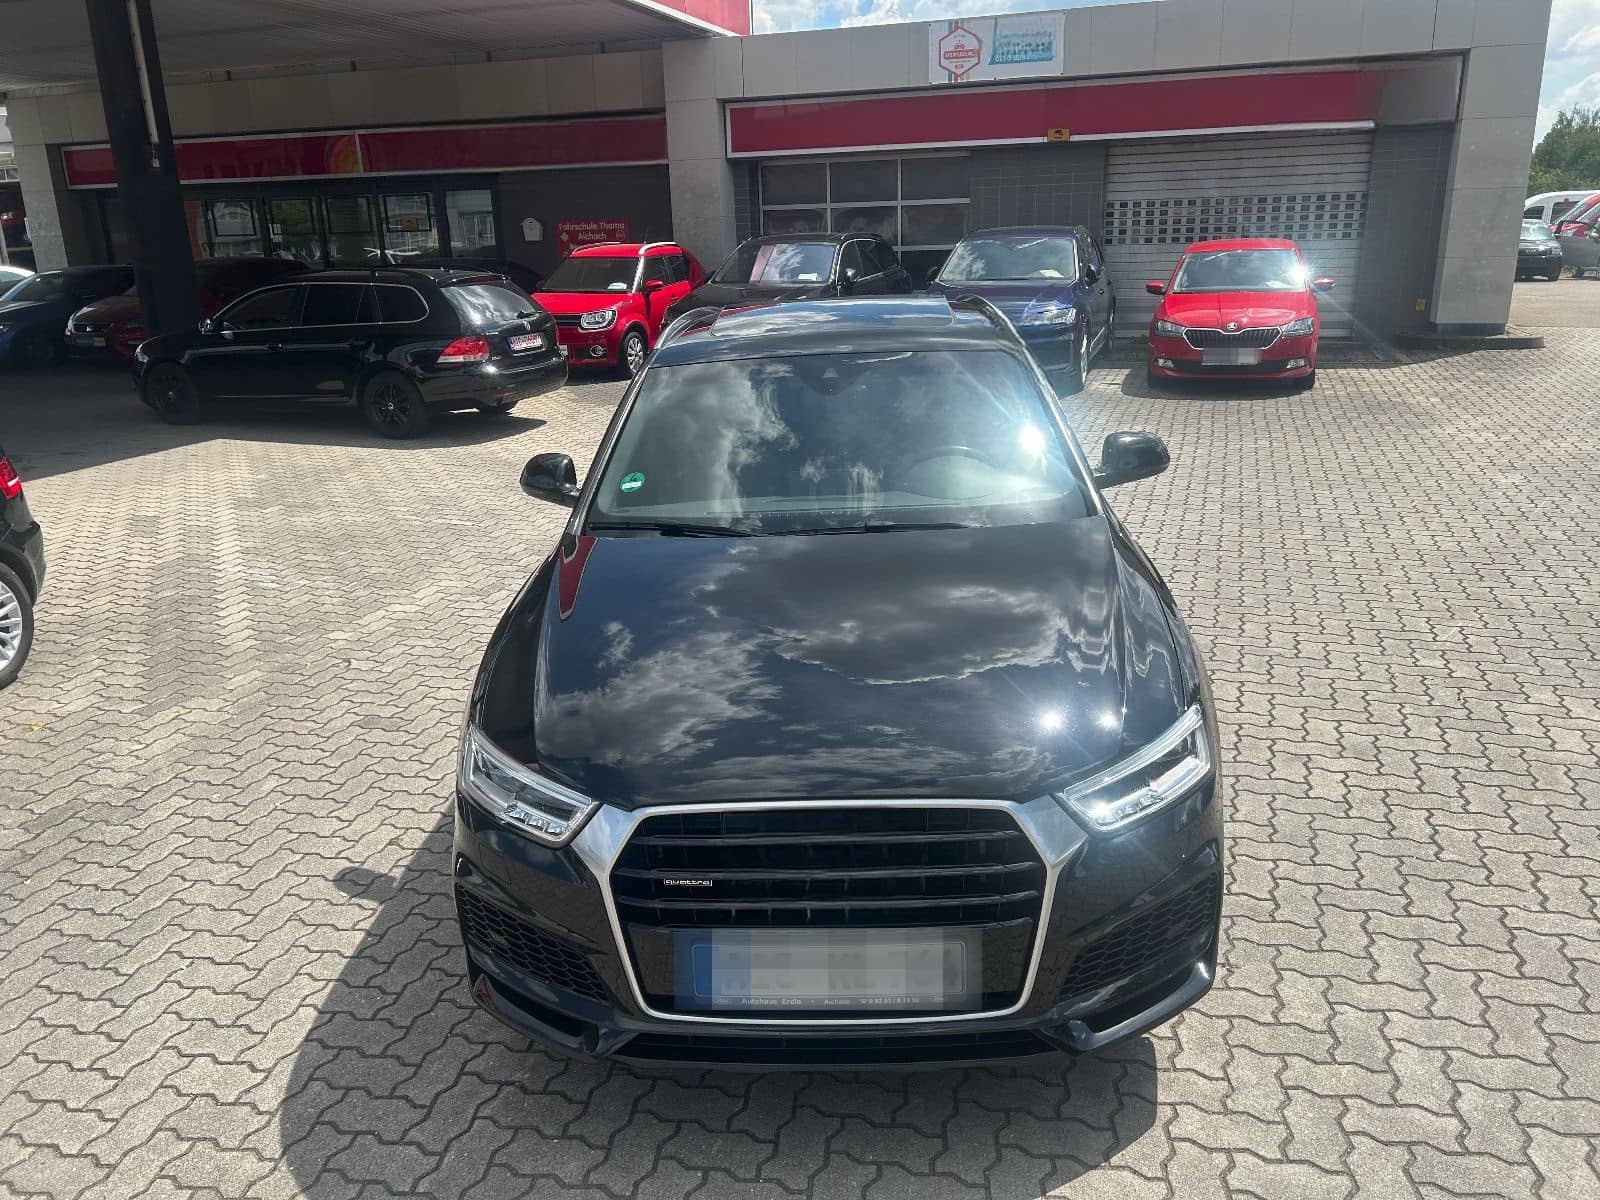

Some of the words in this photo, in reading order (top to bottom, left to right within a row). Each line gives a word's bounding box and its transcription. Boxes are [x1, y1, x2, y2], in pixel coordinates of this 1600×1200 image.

[559, 222, 598, 231] Fahrschule
[599, 222, 625, 230] Thoma
[578, 232, 607, 240] Aichach
[742, 998, 777, 1006] Autohaus
